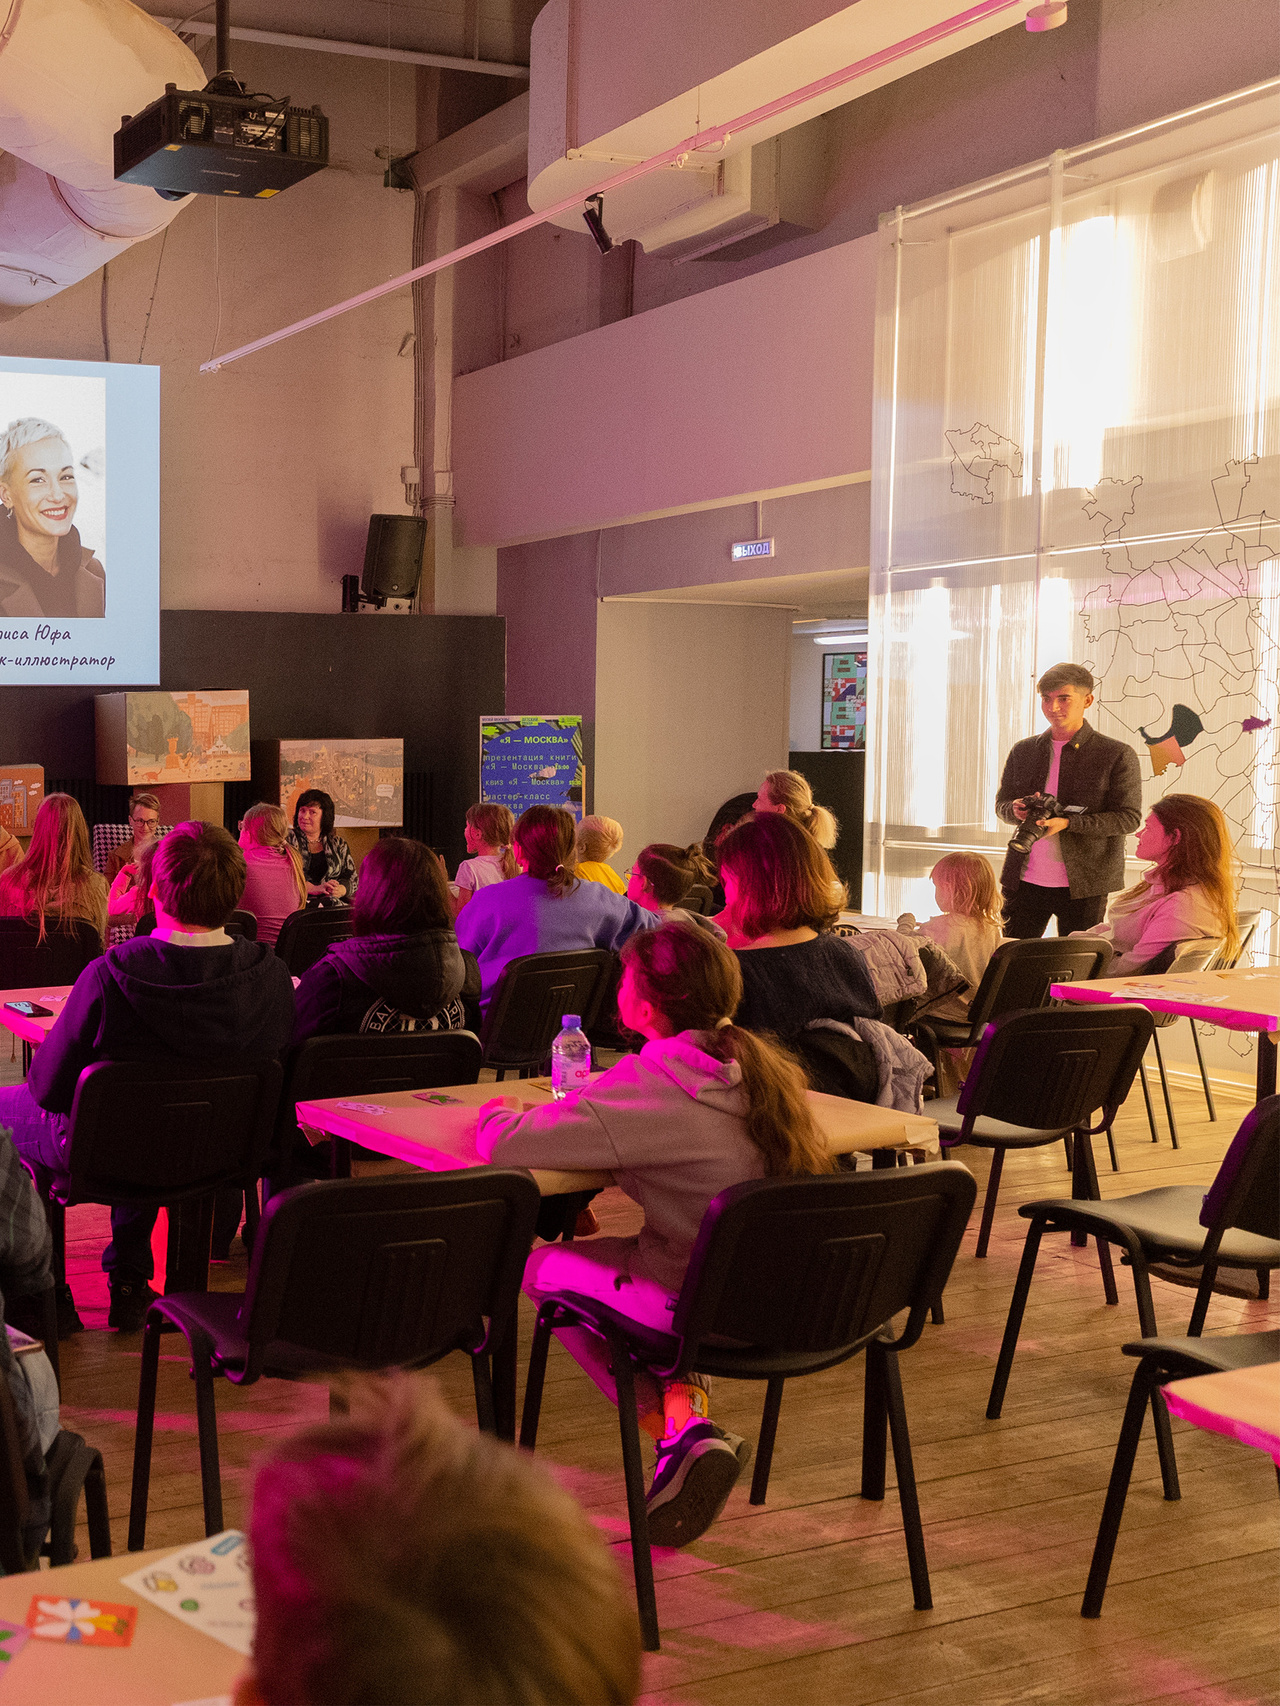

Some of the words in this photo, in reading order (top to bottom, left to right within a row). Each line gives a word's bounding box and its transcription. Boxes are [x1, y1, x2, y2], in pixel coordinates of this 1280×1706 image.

[34, 623, 72, 646] Юфа
[524, 736, 569, 744] МОСКВА»
[531, 778, 565, 786] Москва»
[486, 793, 551, 801] мастер-класс
[369, 1003, 395, 1031] BAL
[447, 1003, 461, 1030] RIS
[575, 1069, 590, 1080] ap
